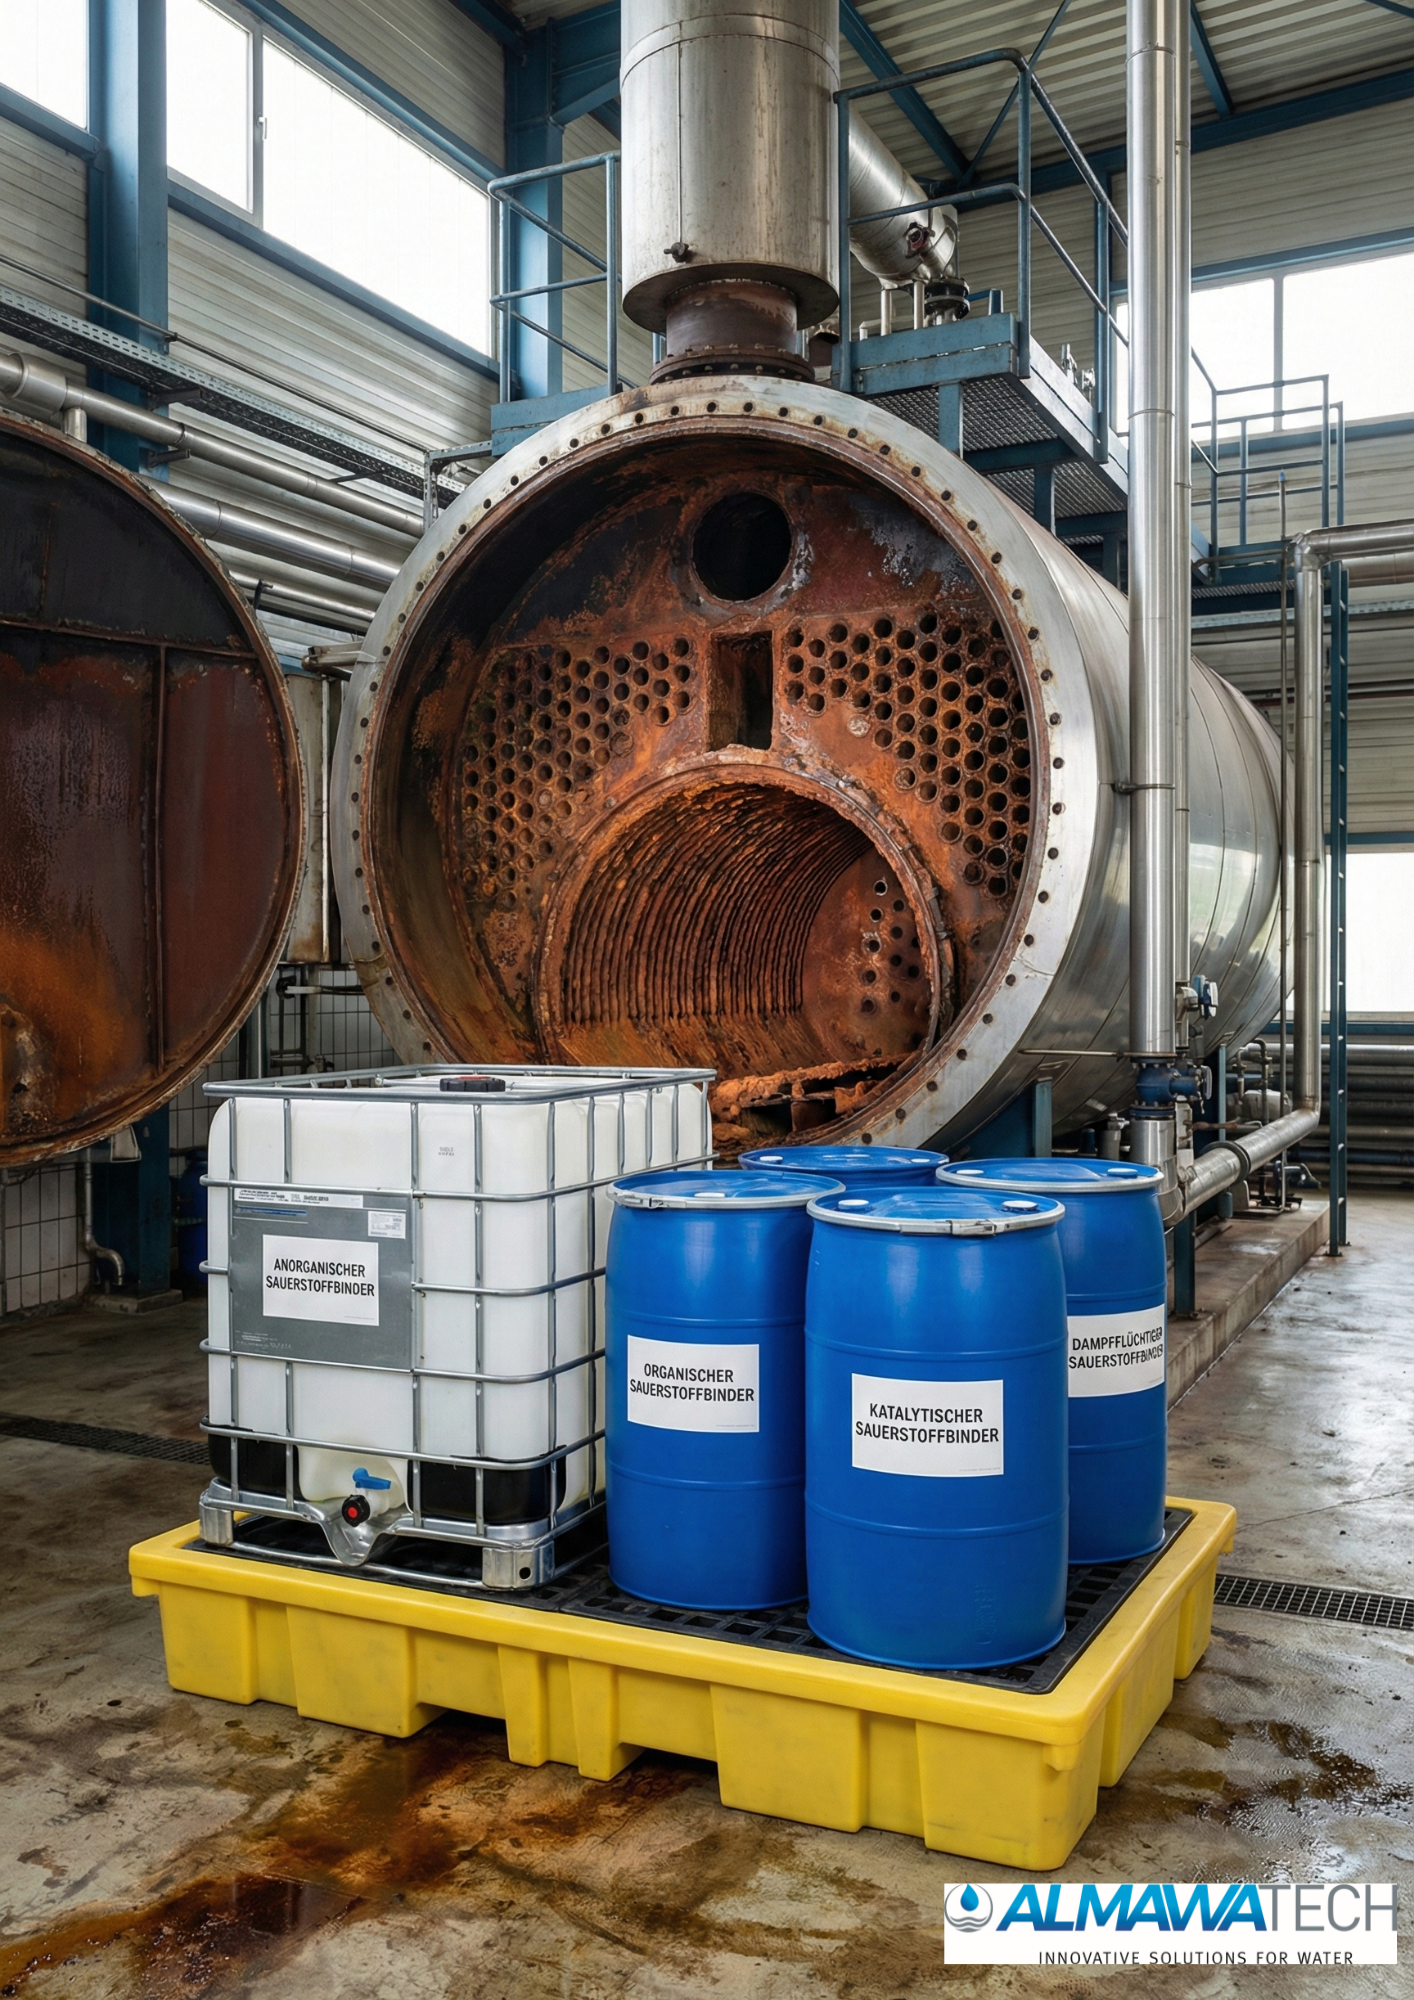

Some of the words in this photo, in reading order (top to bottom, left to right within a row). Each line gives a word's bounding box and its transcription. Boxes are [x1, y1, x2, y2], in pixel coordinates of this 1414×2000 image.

[273, 1258, 366, 1278] ANORGANISCHER
[265, 1275, 376, 1297] SAUERSTOFFBINDER
[643, 1363, 734, 1383] ORGANISCHER
[629, 1379, 755, 1402] SAUERSTOFFBINDER
[869, 1403, 984, 1423] KATALYTISCHER
[855, 1421, 999, 1444] SAUERSTOFFBINDER
